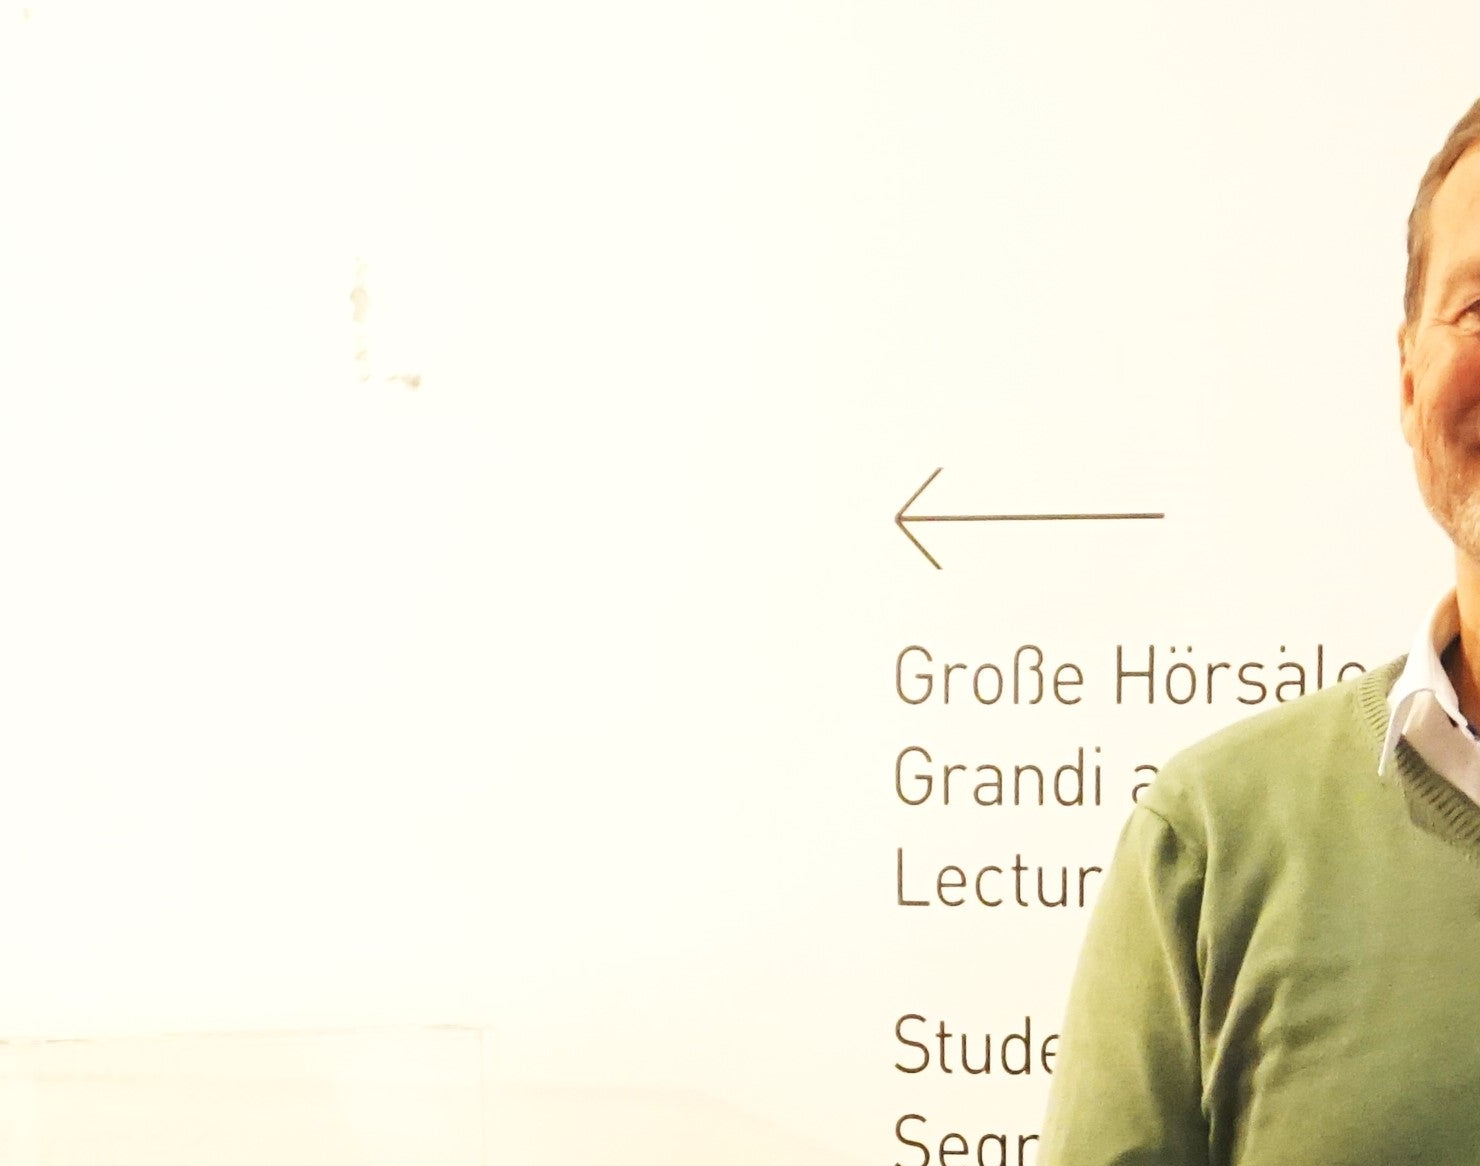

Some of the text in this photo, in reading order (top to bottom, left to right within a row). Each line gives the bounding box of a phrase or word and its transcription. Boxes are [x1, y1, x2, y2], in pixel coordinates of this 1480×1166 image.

[895, 644, 1084, 706] Große
[895, 745, 1102, 807] Grandi
[897, 847, 1102, 908] Lectur
[894, 1013, 1060, 1076] Stude
